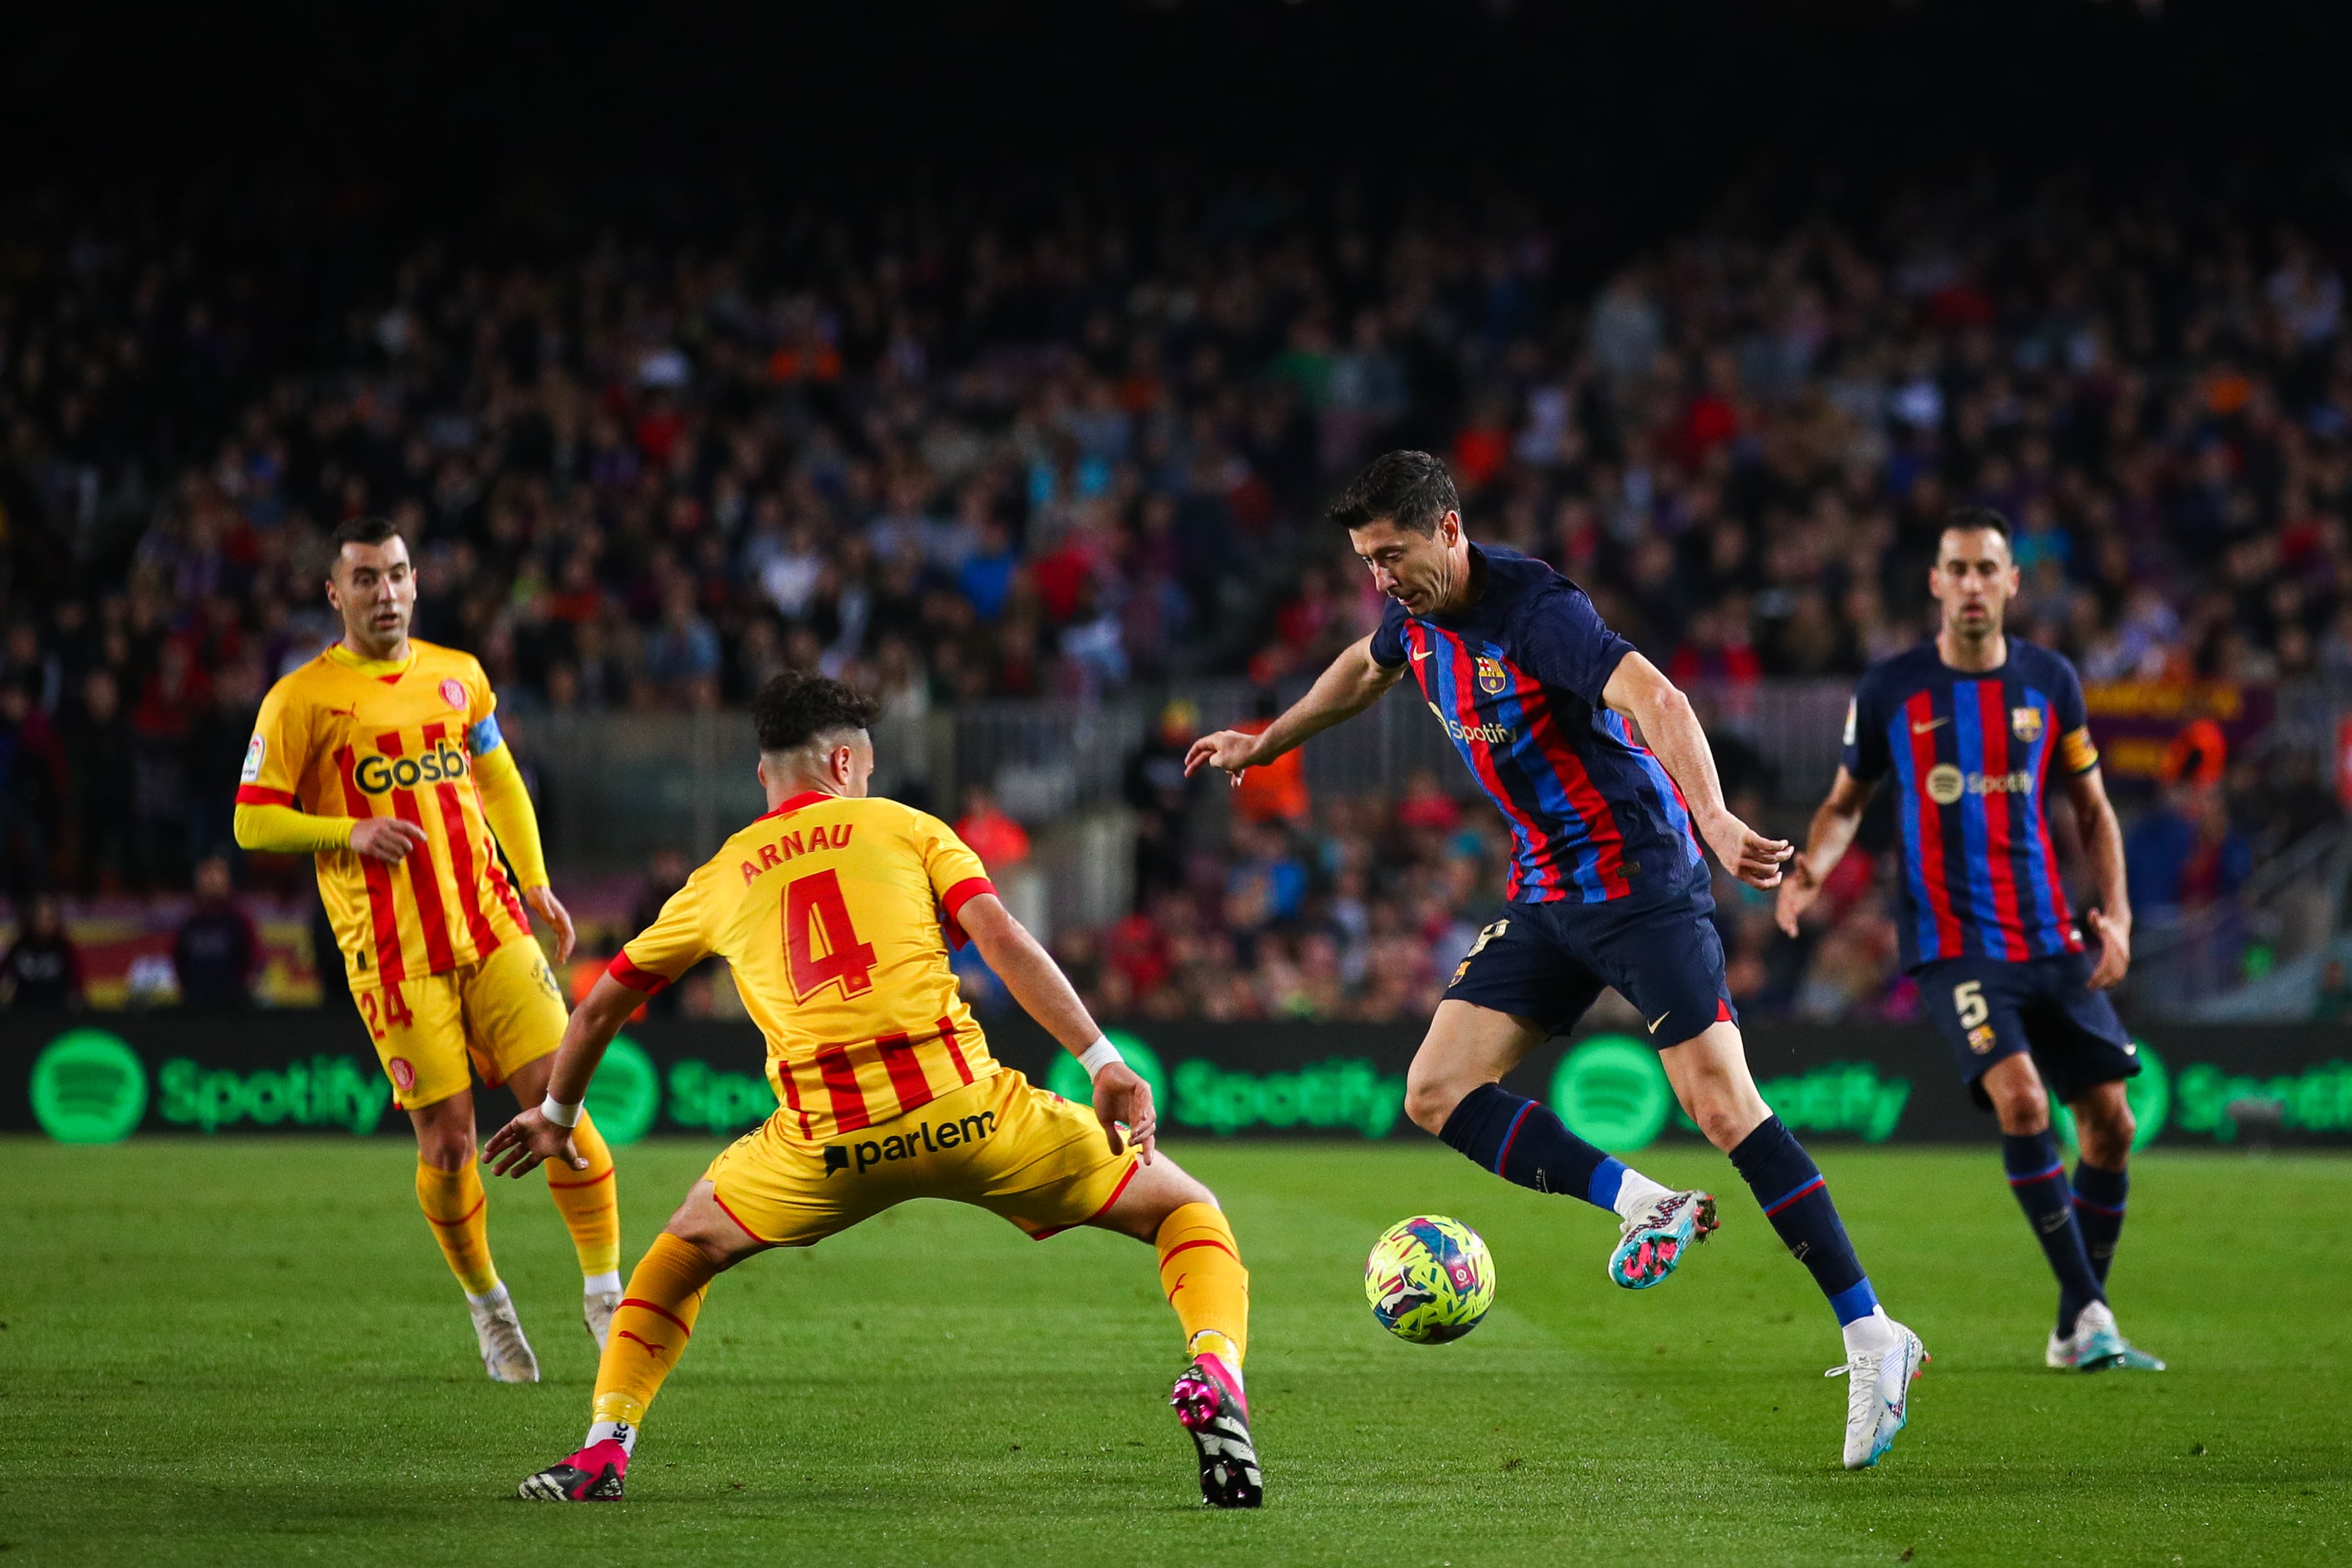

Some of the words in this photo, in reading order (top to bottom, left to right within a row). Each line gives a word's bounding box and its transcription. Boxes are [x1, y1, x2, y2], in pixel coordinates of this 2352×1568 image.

[1449, 719, 1517, 744] Spotify
[1967, 770, 2034, 797] Spotify
[741, 824, 853, 887] ARNAU
[781, 867, 878, 1006] 4
[361, 983, 413, 1041] 24
[1953, 979, 1988, 1030] 5
[159, 1055, 392, 1135] Spotify
[1172, 1057, 1407, 1138] Spotify
[855, 1110, 996, 1174] parlem
